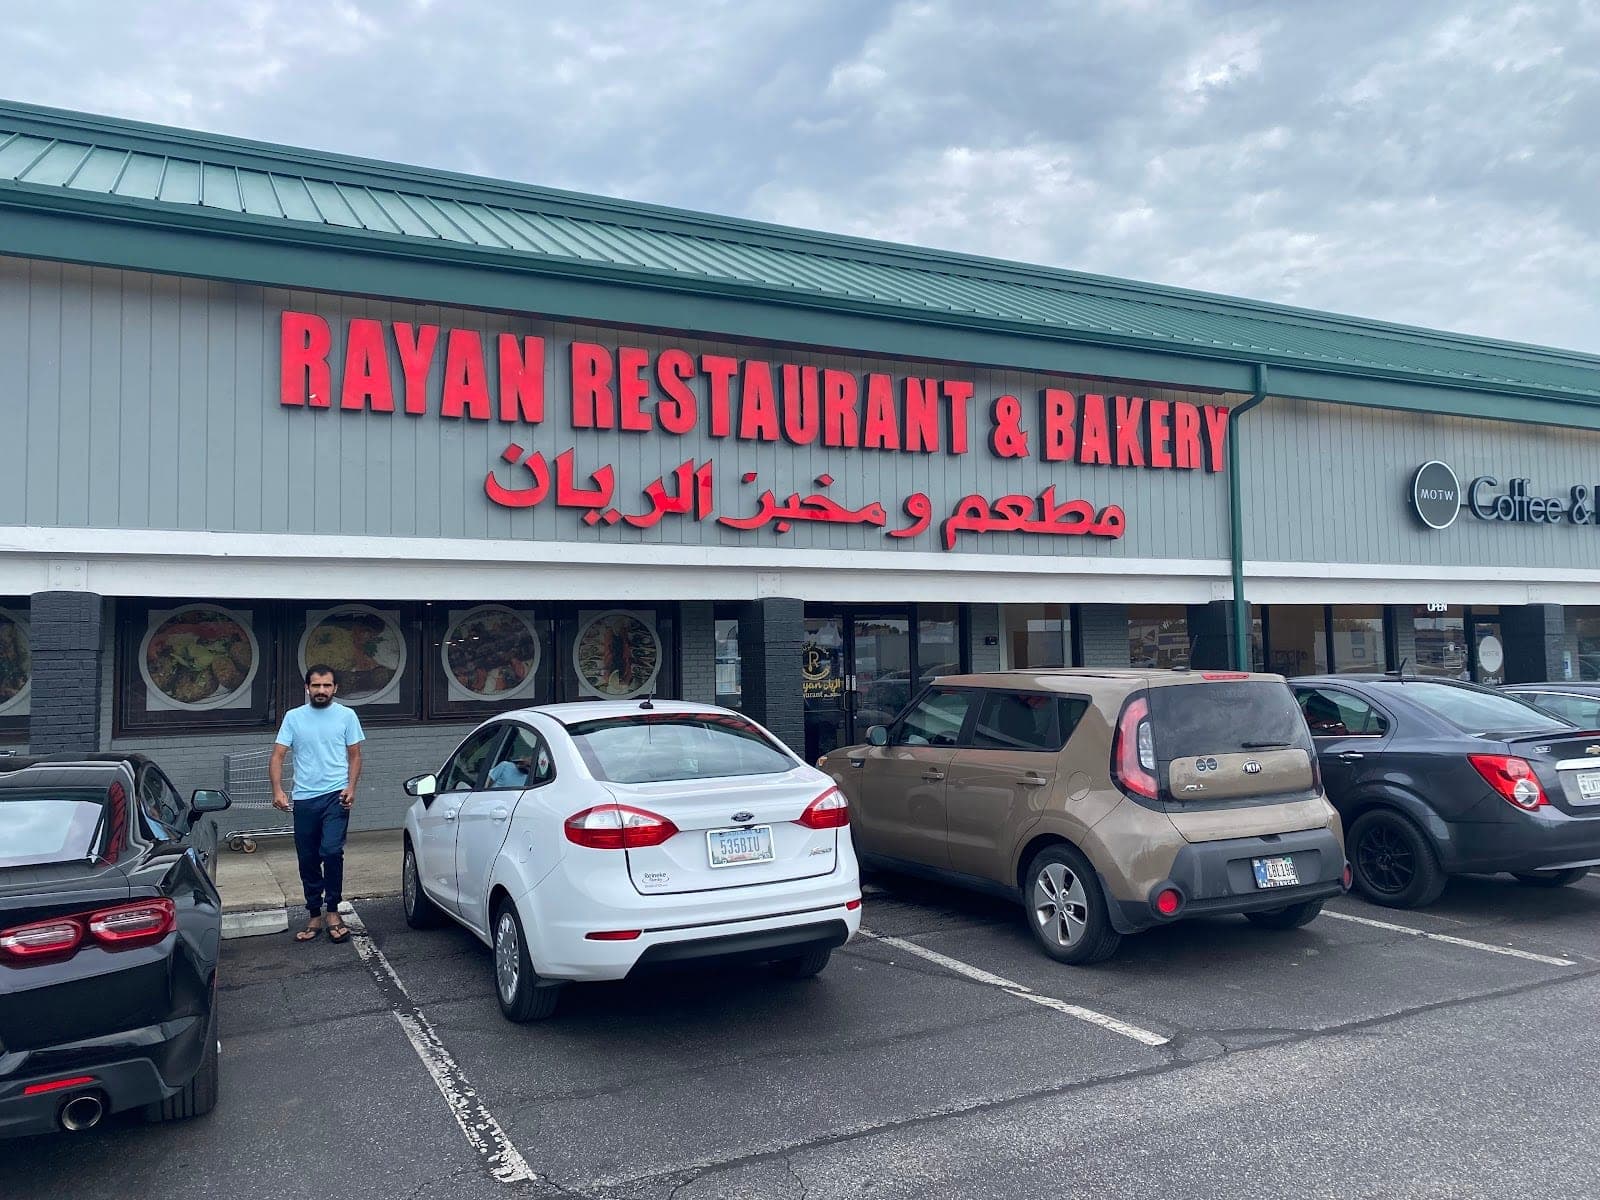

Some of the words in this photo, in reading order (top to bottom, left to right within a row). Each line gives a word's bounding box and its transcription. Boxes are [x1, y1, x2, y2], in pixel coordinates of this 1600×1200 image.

[280, 310, 545, 424] RAYAN
[570, 341, 974, 455] RESTAURANT
[988, 395, 1030, 459] &
[1039, 388, 1230, 473] BAKERY
[484, 443, 713, 529] الريان
[1420, 488, 1454, 501] MOTW
[1468, 475, 1563, 524] Coffee
[1567, 484, 1592, 525] &
[940, 484, 1126, 551] مطعم
[1427, 602, 1448, 612] OPEN
[720, 836, 760, 855] 535BIU
